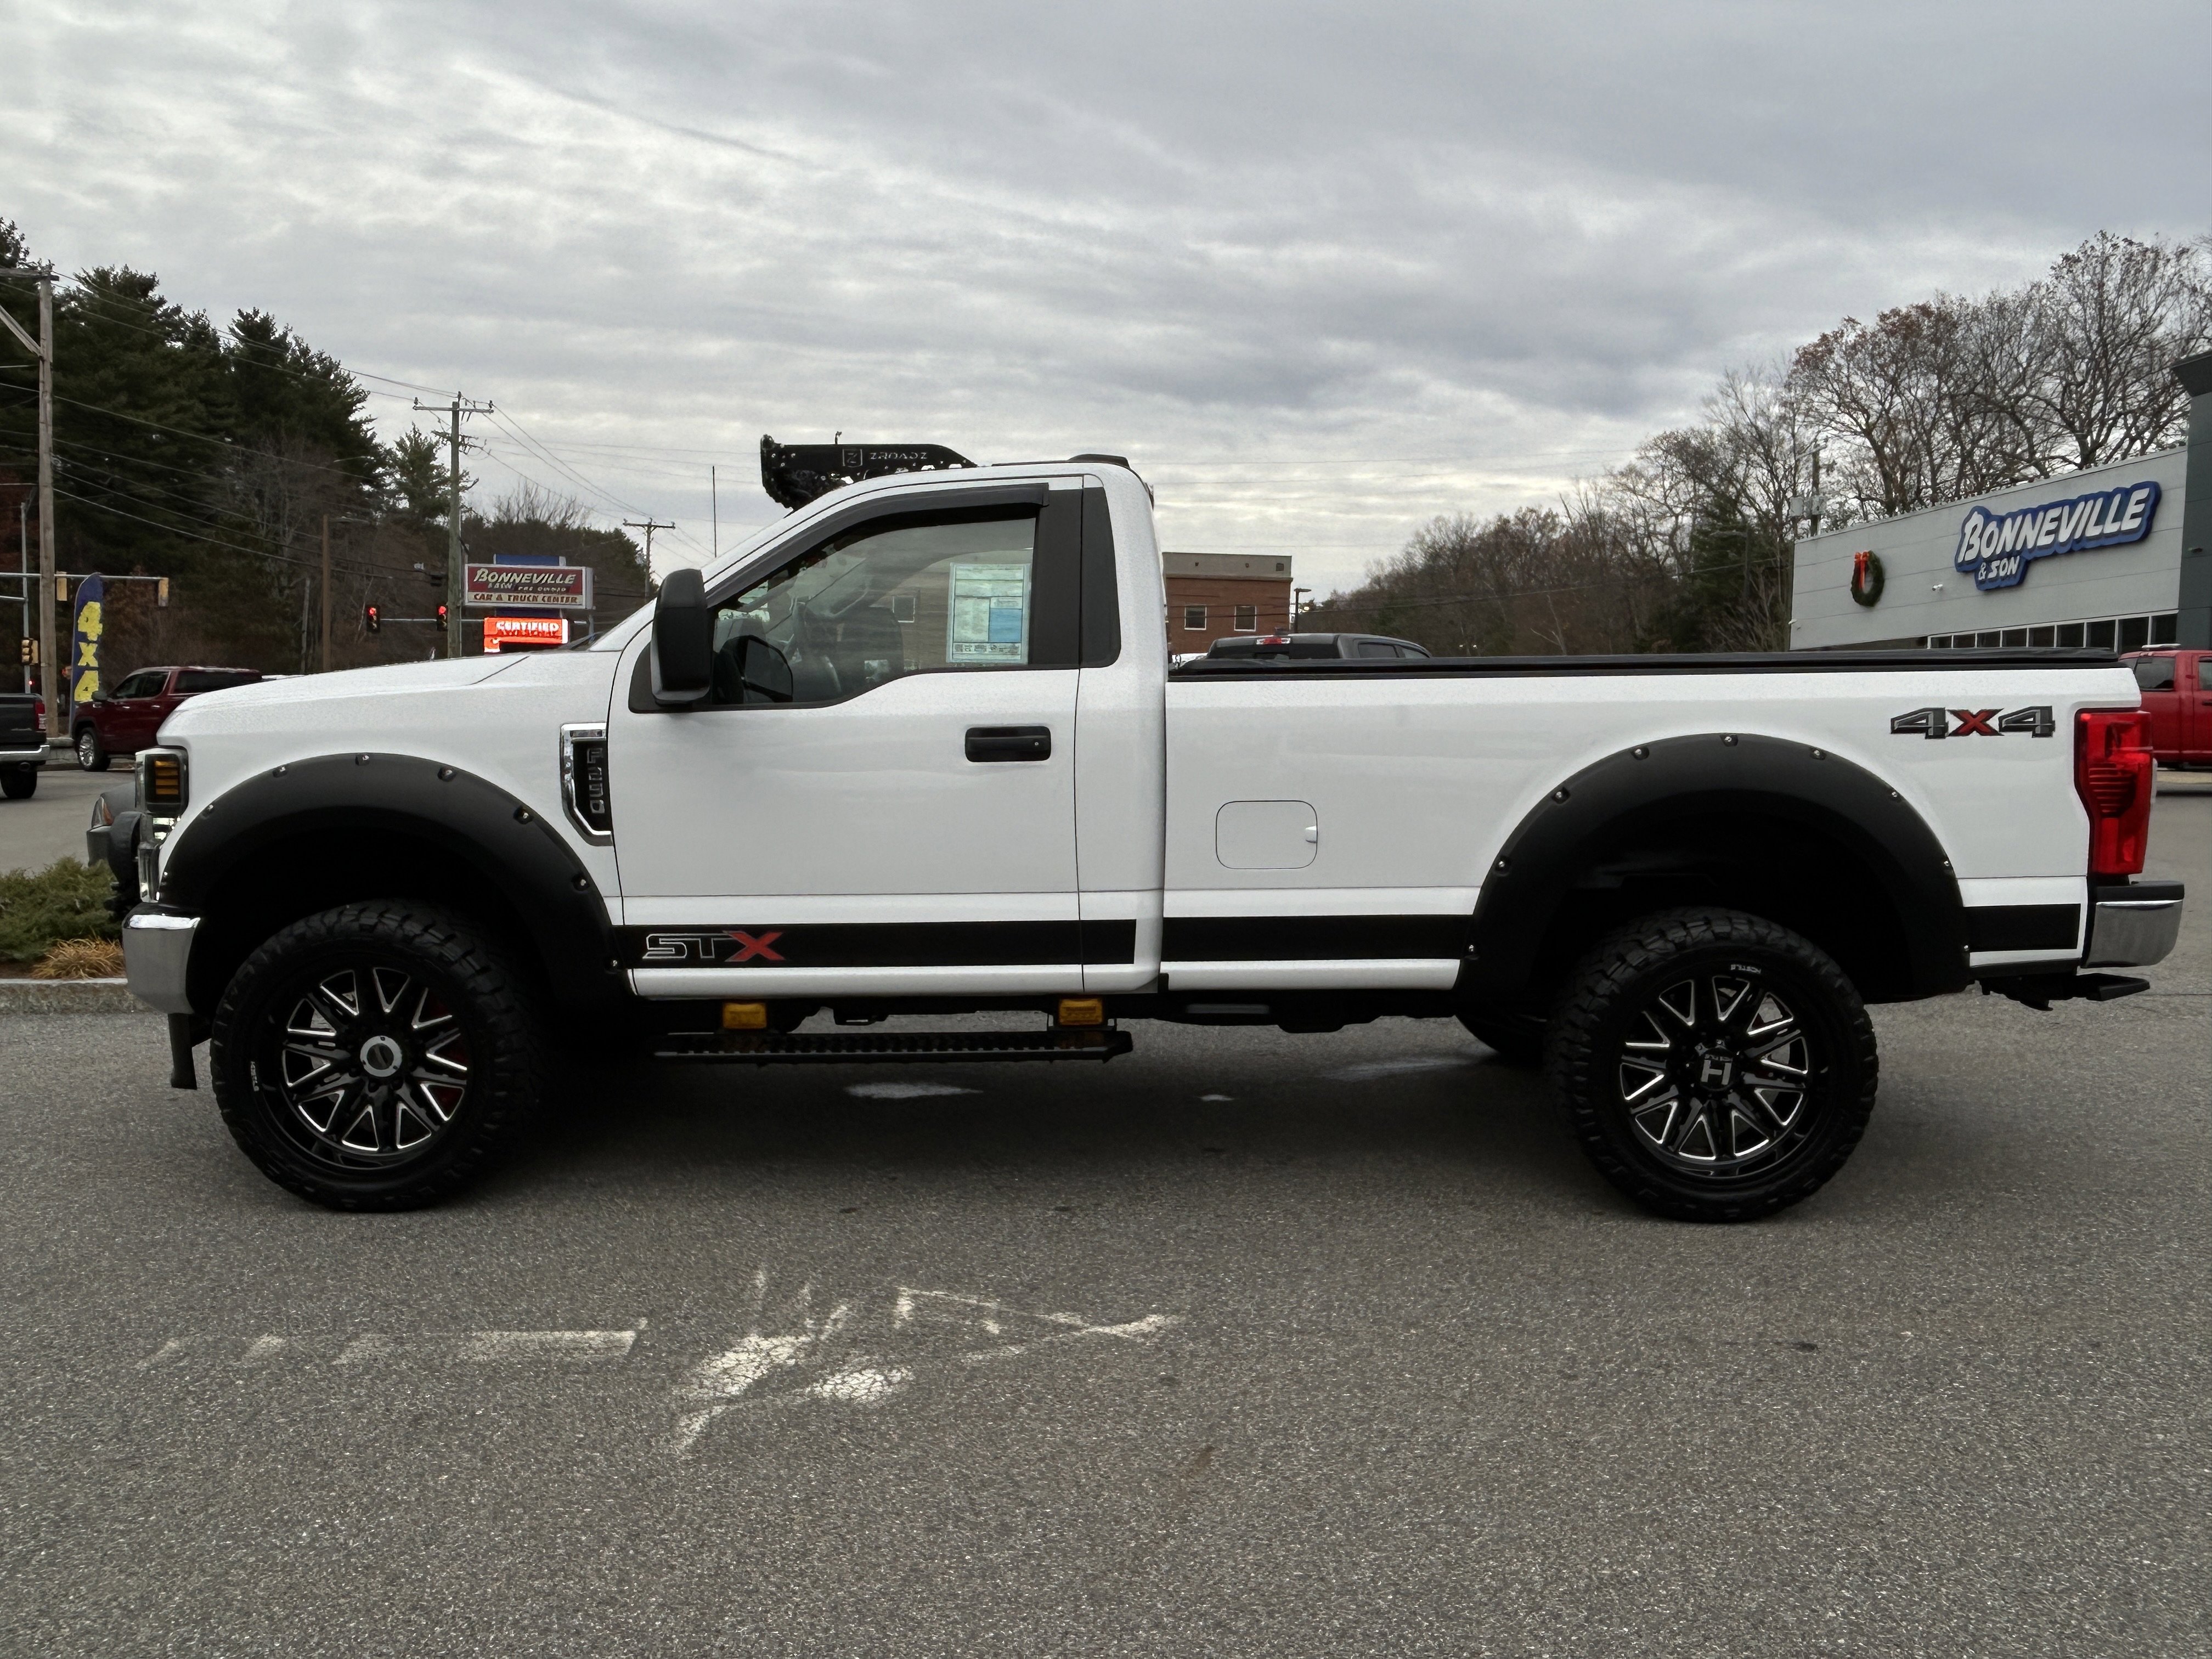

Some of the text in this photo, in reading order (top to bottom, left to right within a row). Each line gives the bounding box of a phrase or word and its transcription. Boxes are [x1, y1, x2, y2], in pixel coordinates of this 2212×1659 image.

[1957, 487, 2150, 563] BONNEVILLE
[473, 568, 576, 584] BONNEVILLE
[1978, 555, 2020, 580] & SON
[642, 930, 786, 962] STX
